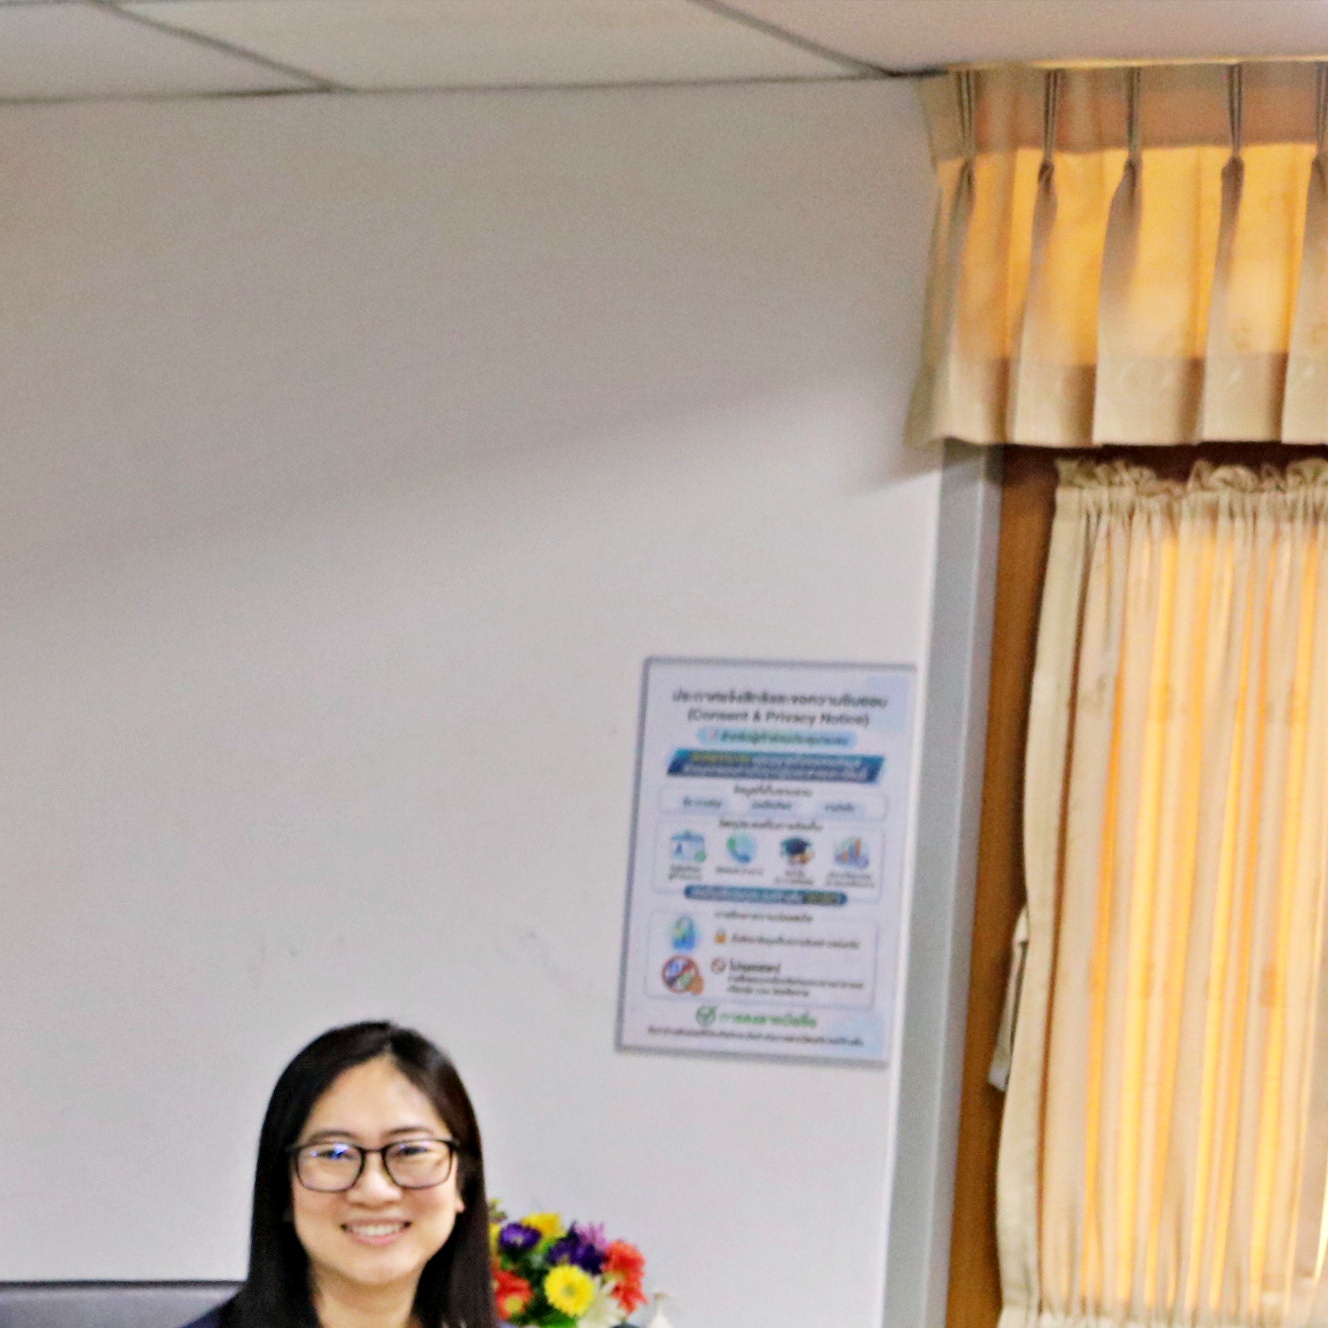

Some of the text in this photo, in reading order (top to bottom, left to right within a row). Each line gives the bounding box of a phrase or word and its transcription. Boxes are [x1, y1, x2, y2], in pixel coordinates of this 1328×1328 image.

[687, 708, 748, 723] (Consent
[766, 711, 816, 728] Privacy
[821, 713, 870, 728] Notice)
